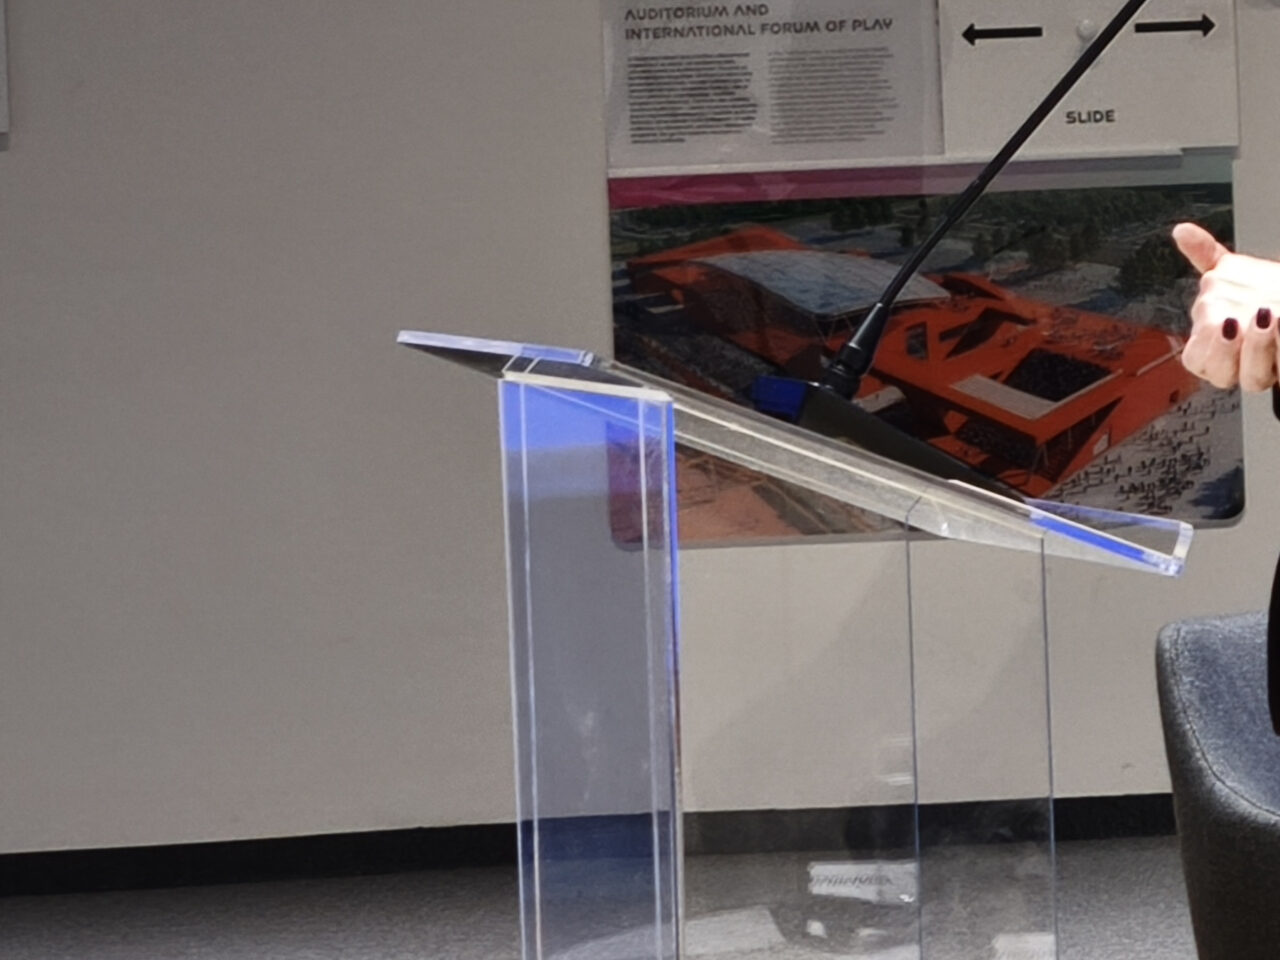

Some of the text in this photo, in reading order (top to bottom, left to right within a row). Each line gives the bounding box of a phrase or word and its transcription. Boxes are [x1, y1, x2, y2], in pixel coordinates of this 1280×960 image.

[625, 3, 769, 21] AUDITORIUM AND
[625, 17, 893, 41] INTERNATIONAL FORUM OF PLAY
[1065, 109, 1116, 124] SLIDE
